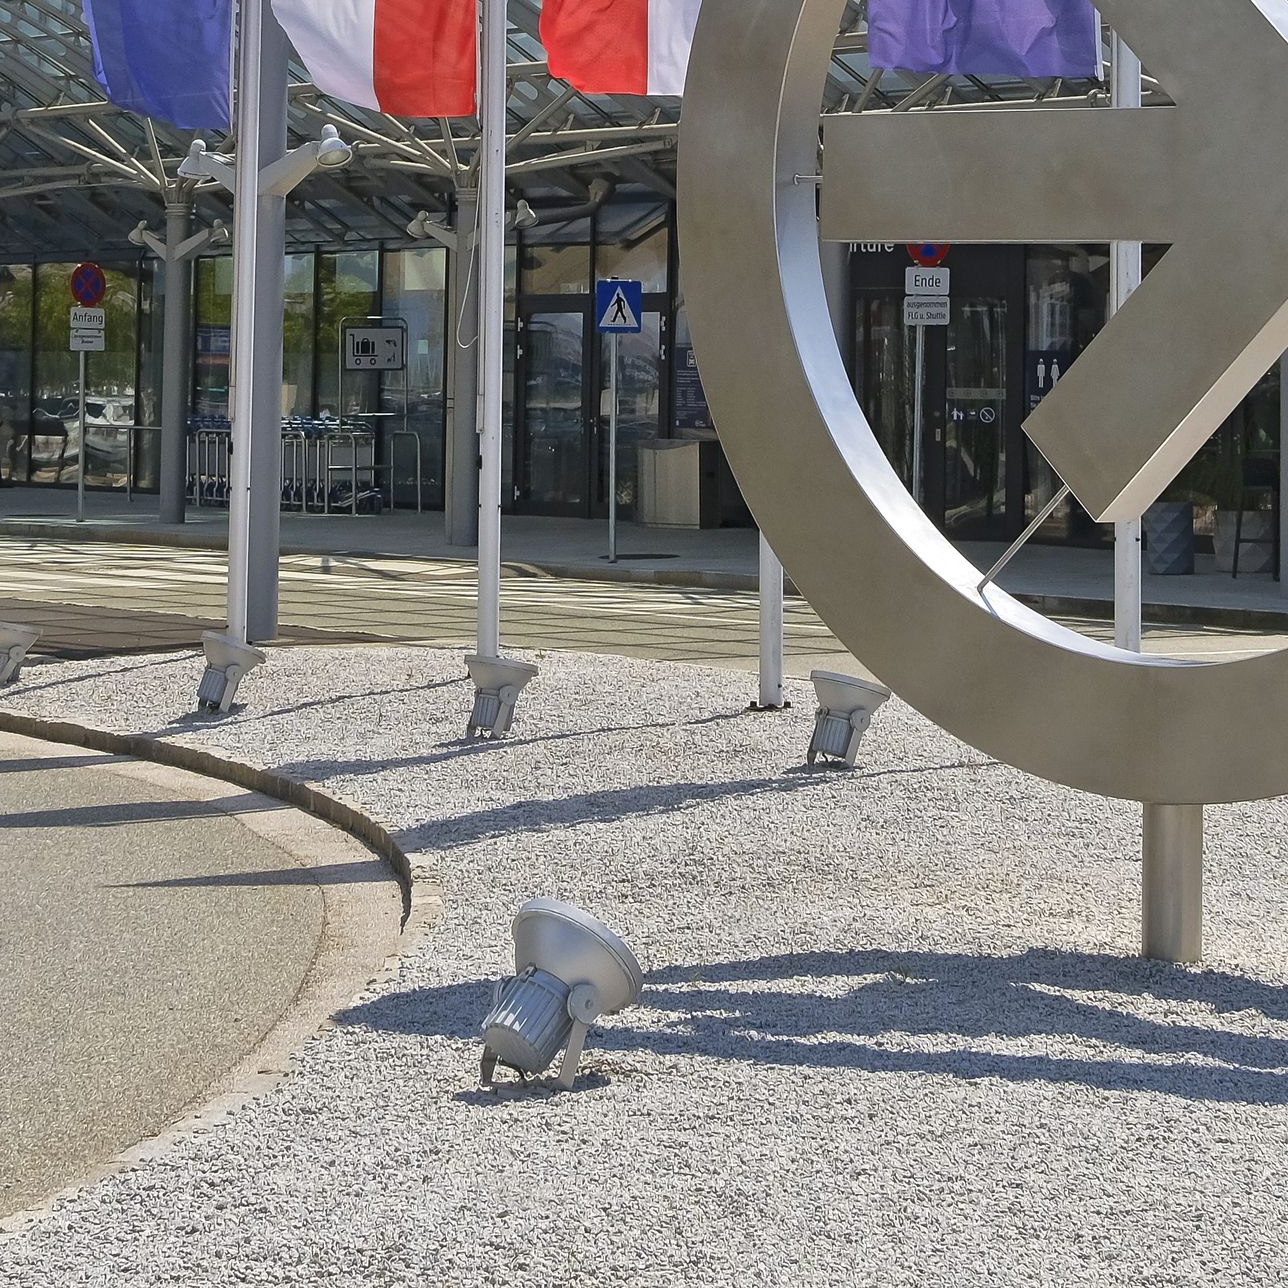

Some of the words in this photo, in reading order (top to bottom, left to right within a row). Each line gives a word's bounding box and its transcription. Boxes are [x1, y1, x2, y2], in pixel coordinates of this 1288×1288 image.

[914, 274, 941, 288] Ende
[72, 312, 104, 325] Anfang
[907, 312, 918, 320] FLG
[925, 312, 947, 320] Shuttle
